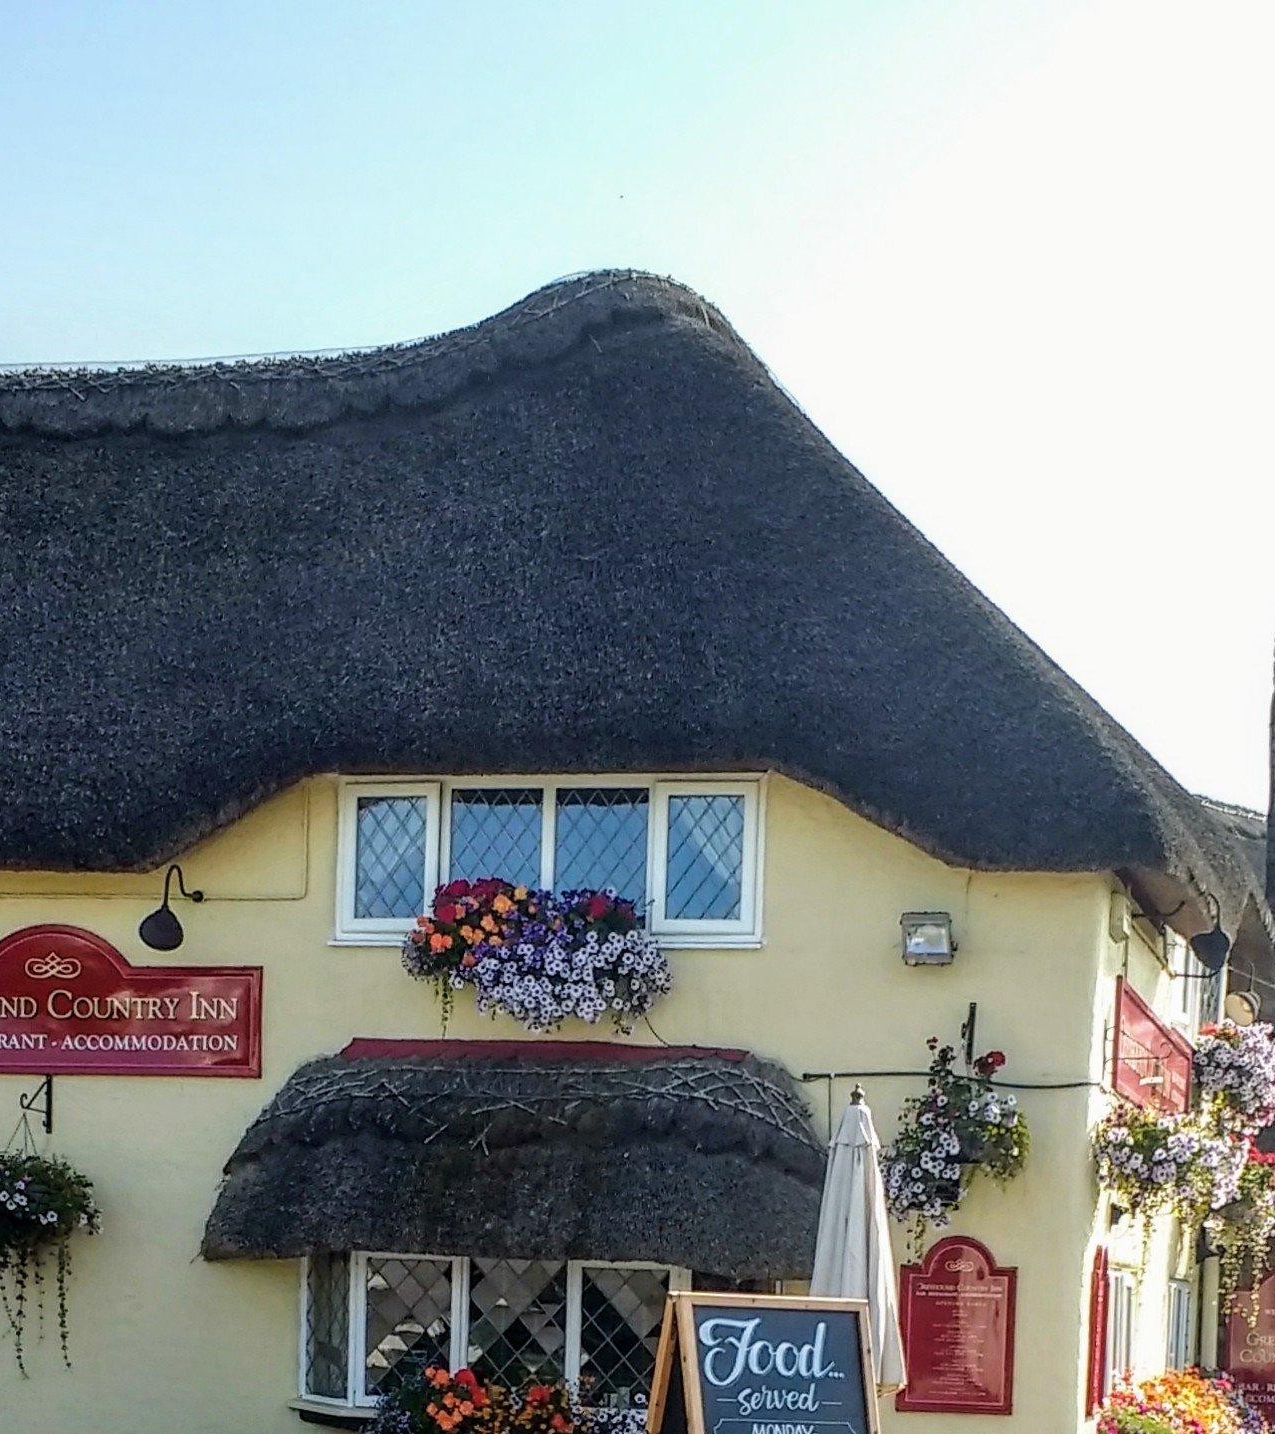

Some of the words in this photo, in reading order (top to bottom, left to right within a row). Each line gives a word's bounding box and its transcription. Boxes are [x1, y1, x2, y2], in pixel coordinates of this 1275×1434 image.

[46, 989, 180, 1020] COUNTRY
[189, 990, 238, 1020] INN
[61, 1034, 238, 1051] ACCOMMODATION
[737, 1383, 820, 1416] served
